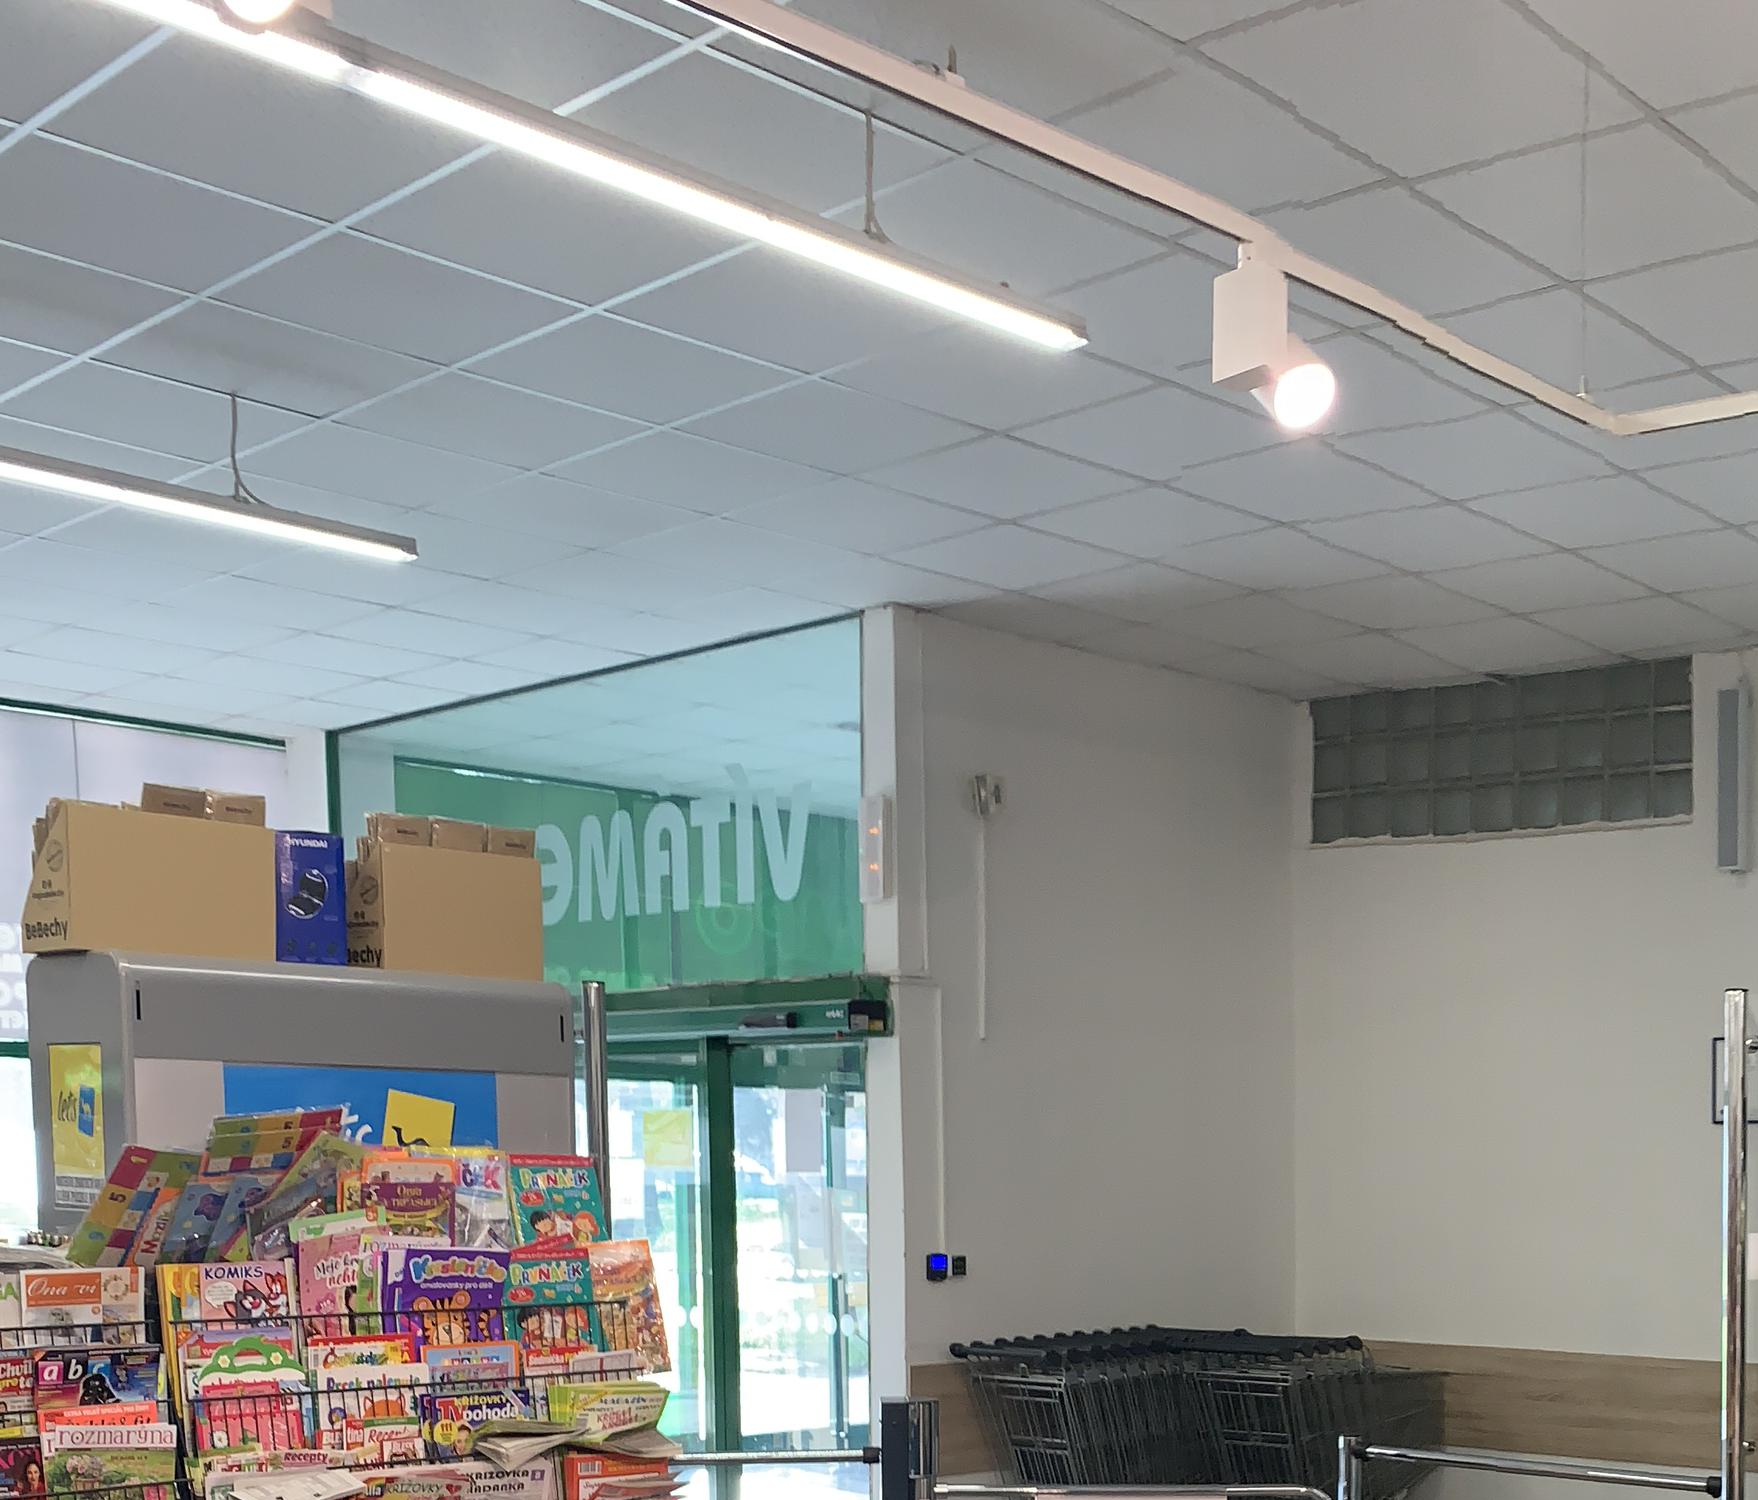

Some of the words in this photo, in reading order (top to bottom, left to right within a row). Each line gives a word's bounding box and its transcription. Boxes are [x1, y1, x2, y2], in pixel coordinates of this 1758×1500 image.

[25, 917, 68, 941] BeBechy
[204, 1264, 264, 1281] KOMIKS
[28, 1277, 68, 1297] Ona
[59, 1425, 174, 1446] rozmarýna
[283, 1450, 329, 1465] Recepty
